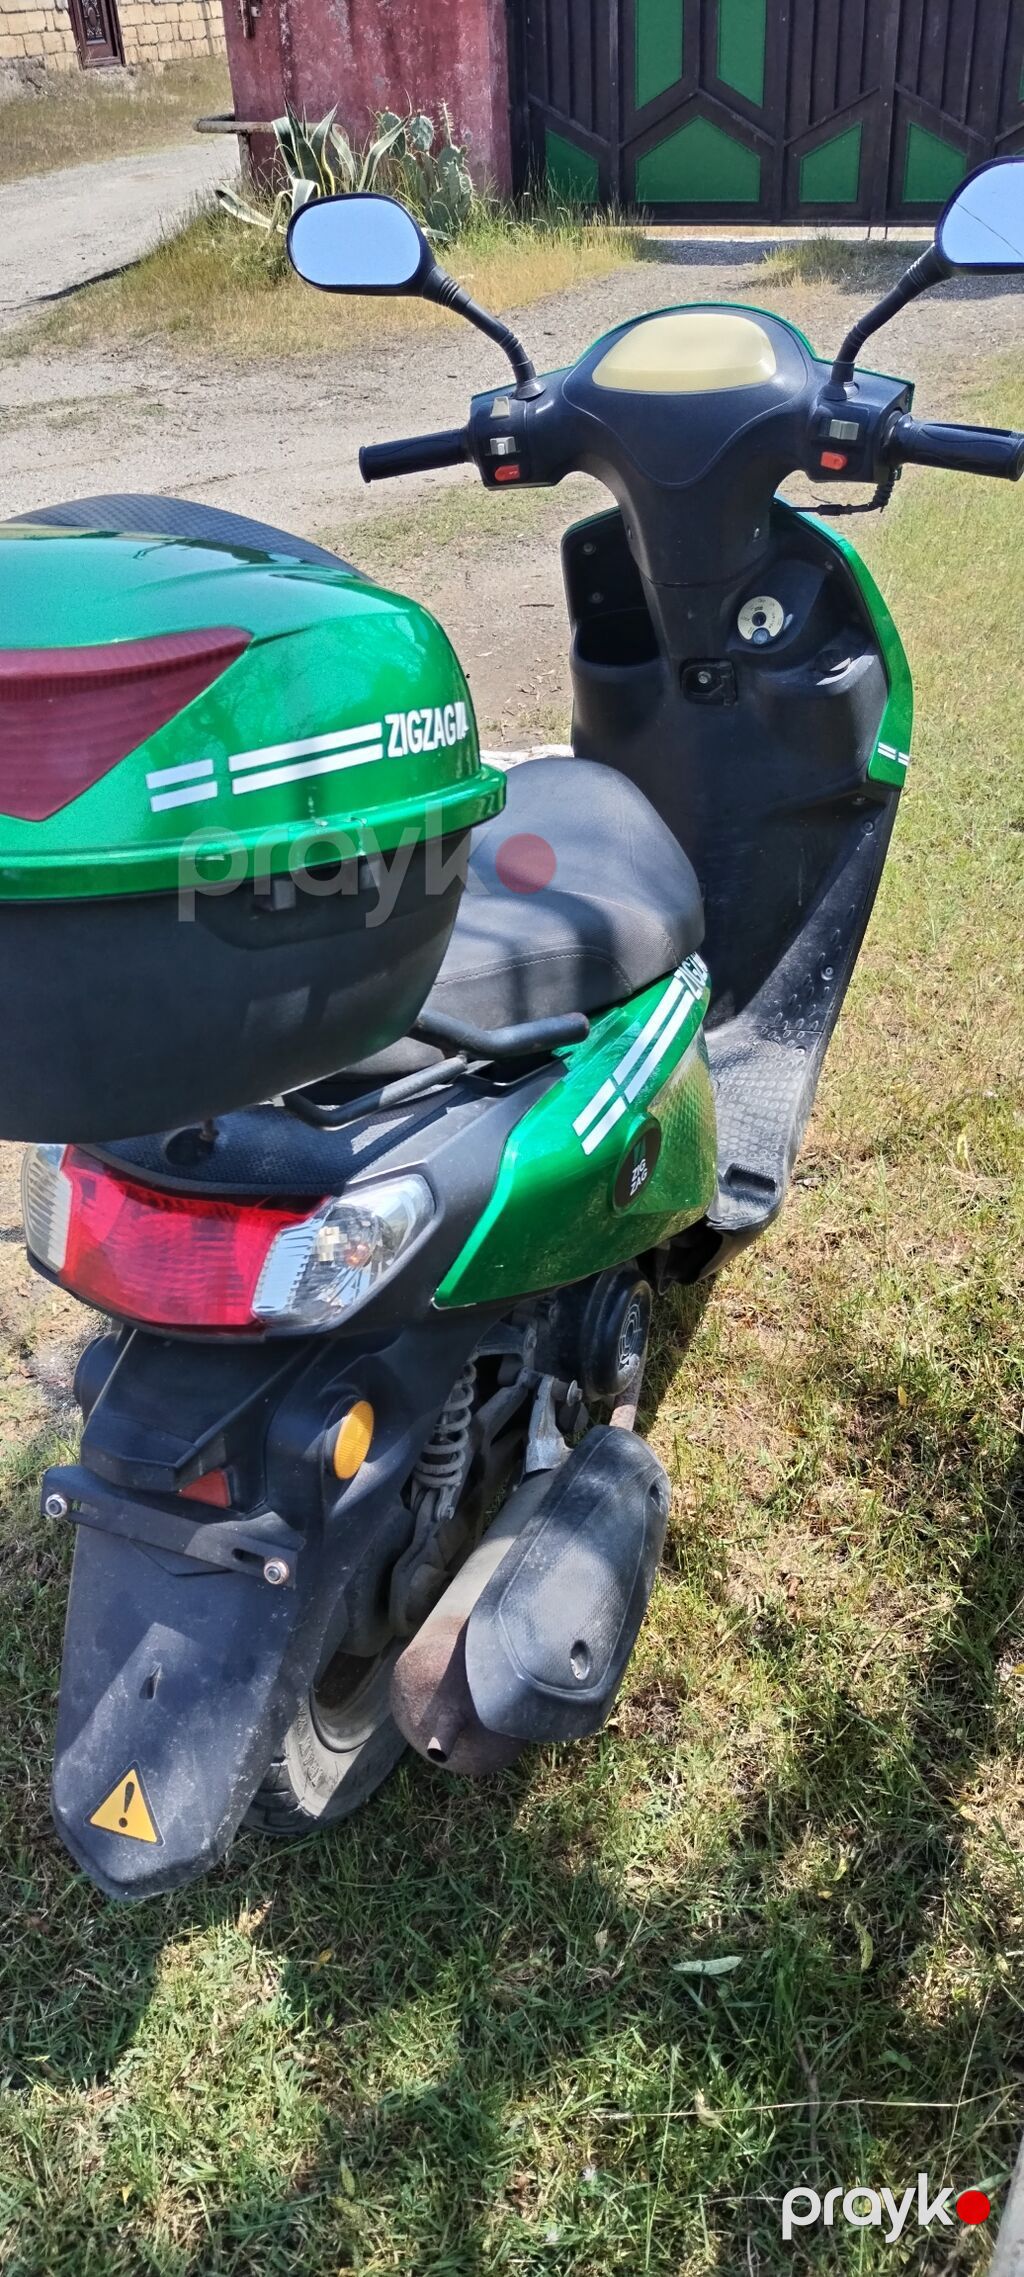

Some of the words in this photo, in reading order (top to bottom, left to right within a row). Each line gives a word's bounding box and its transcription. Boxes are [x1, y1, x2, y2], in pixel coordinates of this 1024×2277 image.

[384, 704, 457, 758] ZIGZAG
[629, 1168, 648, 1196] ZAG
[631, 1158, 646, 1182] ZIG
